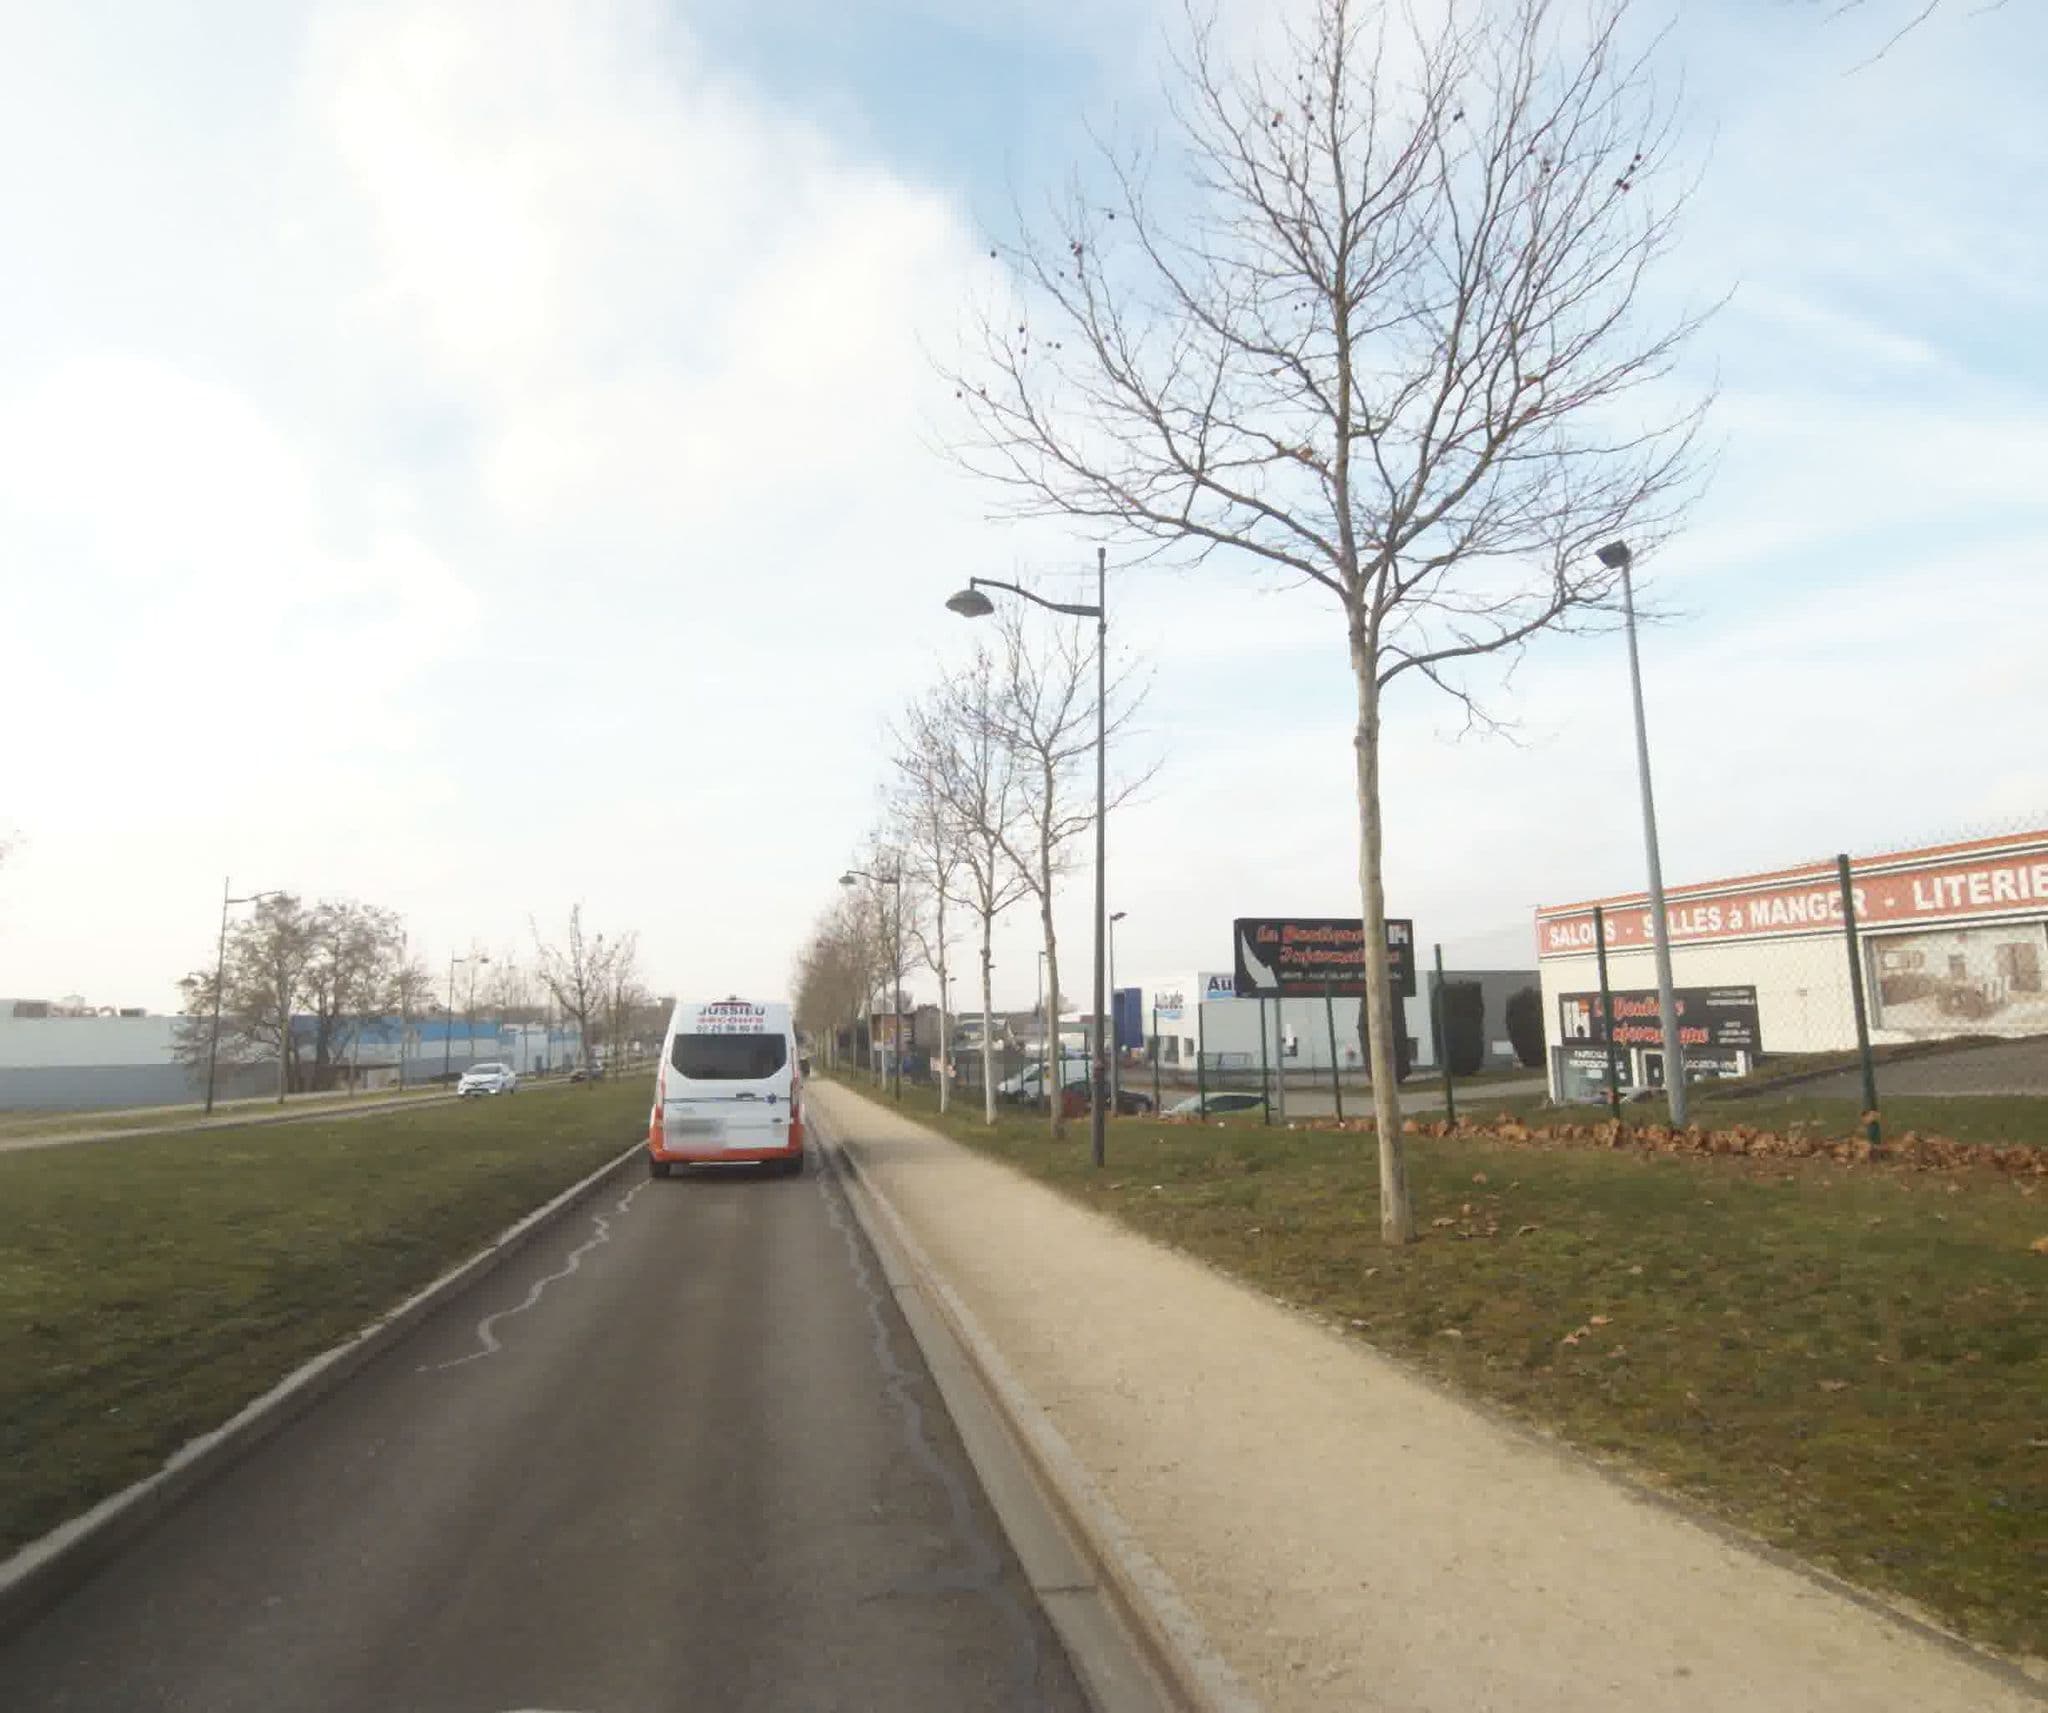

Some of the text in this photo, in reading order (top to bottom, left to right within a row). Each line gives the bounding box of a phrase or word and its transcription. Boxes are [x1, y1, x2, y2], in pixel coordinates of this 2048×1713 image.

[1642, 906, 1720, 937] SLLES
[1749, 887, 1868, 928] MANGER
[1913, 864, 2048, 910] LITERIE
